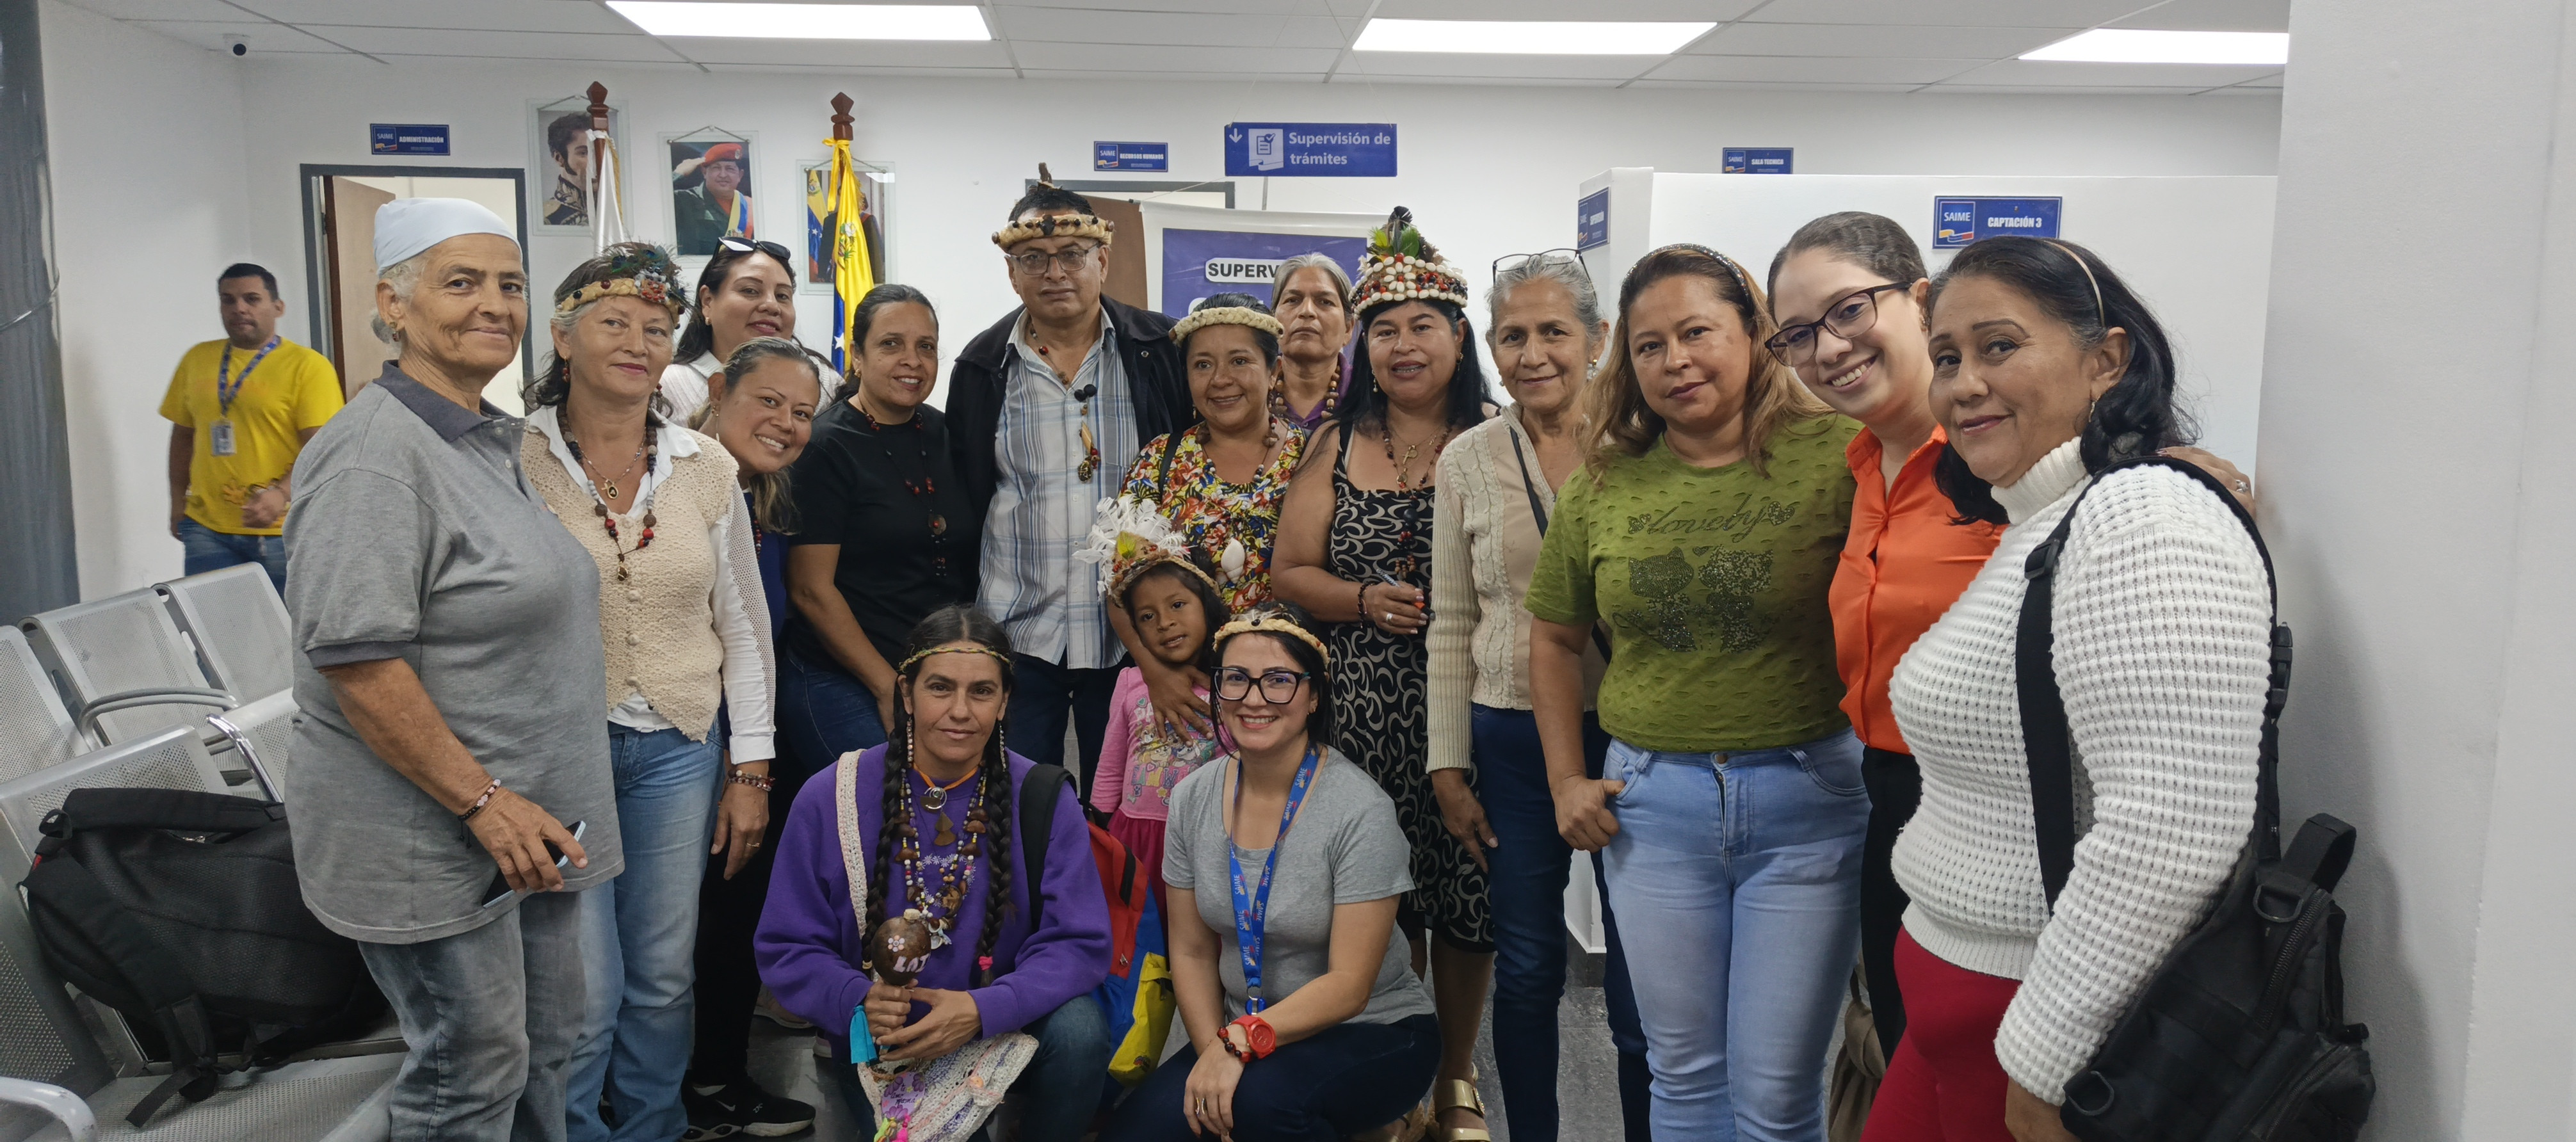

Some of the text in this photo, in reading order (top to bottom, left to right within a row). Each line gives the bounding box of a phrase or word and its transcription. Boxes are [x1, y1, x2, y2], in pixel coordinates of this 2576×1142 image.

[1289, 132, 1391, 147] Supervisión de
[1290, 152, 1348, 165] trámites
[1944, 212, 1971, 221] SAIME
[1988, 216, 2042, 228] CAPTACIÓN 3
[1647, 493, 1766, 543] lovely
[1295, 768, 1307, 786] SAIME
[1237, 910, 1246, 930] SAIME
[1243, 945, 1251, 965] SAIME
